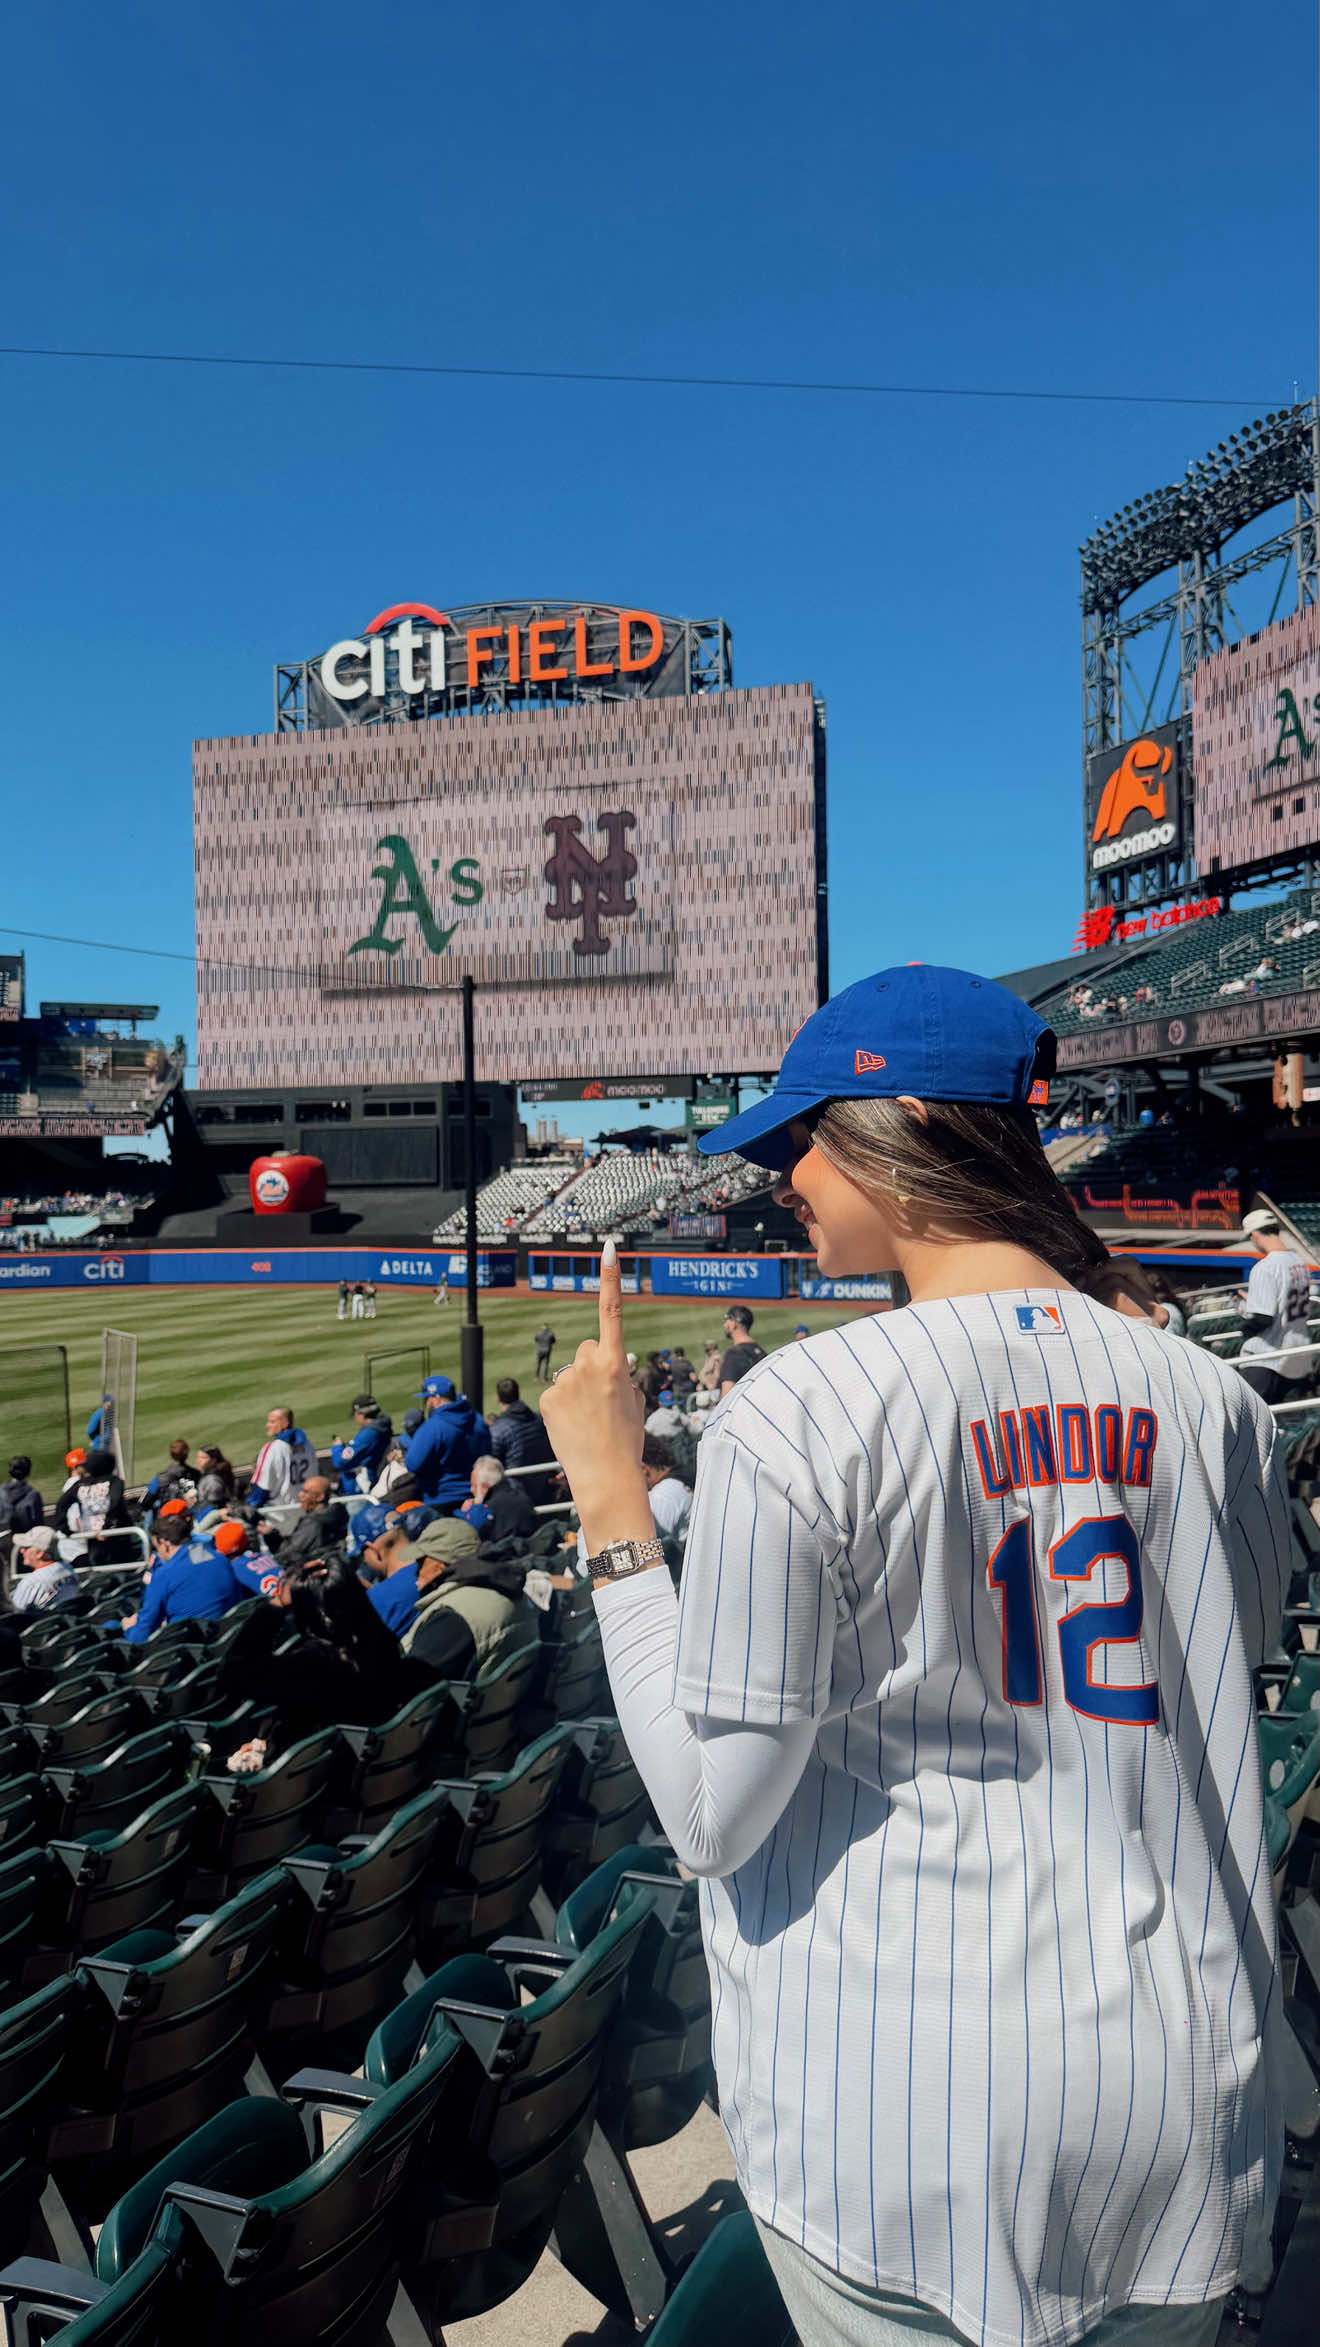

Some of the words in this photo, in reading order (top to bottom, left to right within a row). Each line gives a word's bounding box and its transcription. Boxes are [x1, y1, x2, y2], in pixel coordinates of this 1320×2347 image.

[321, 619, 446, 700] citi
[466, 611, 664, 688] FIELD
[1093, 823, 1176, 869] moomoo
[346, 834, 485, 955] A's
[1116, 918, 1148, 940] new
[1151, 896, 1220, 930] balance
[83, 1259, 124, 1279] citi
[391, 1260, 433, 1275] DELTA
[668, 1261, 759, 1279] HENDRICK'S
[970, 1403, 1158, 1500] LINDOR
[986, 1513, 1160, 1726] 12
